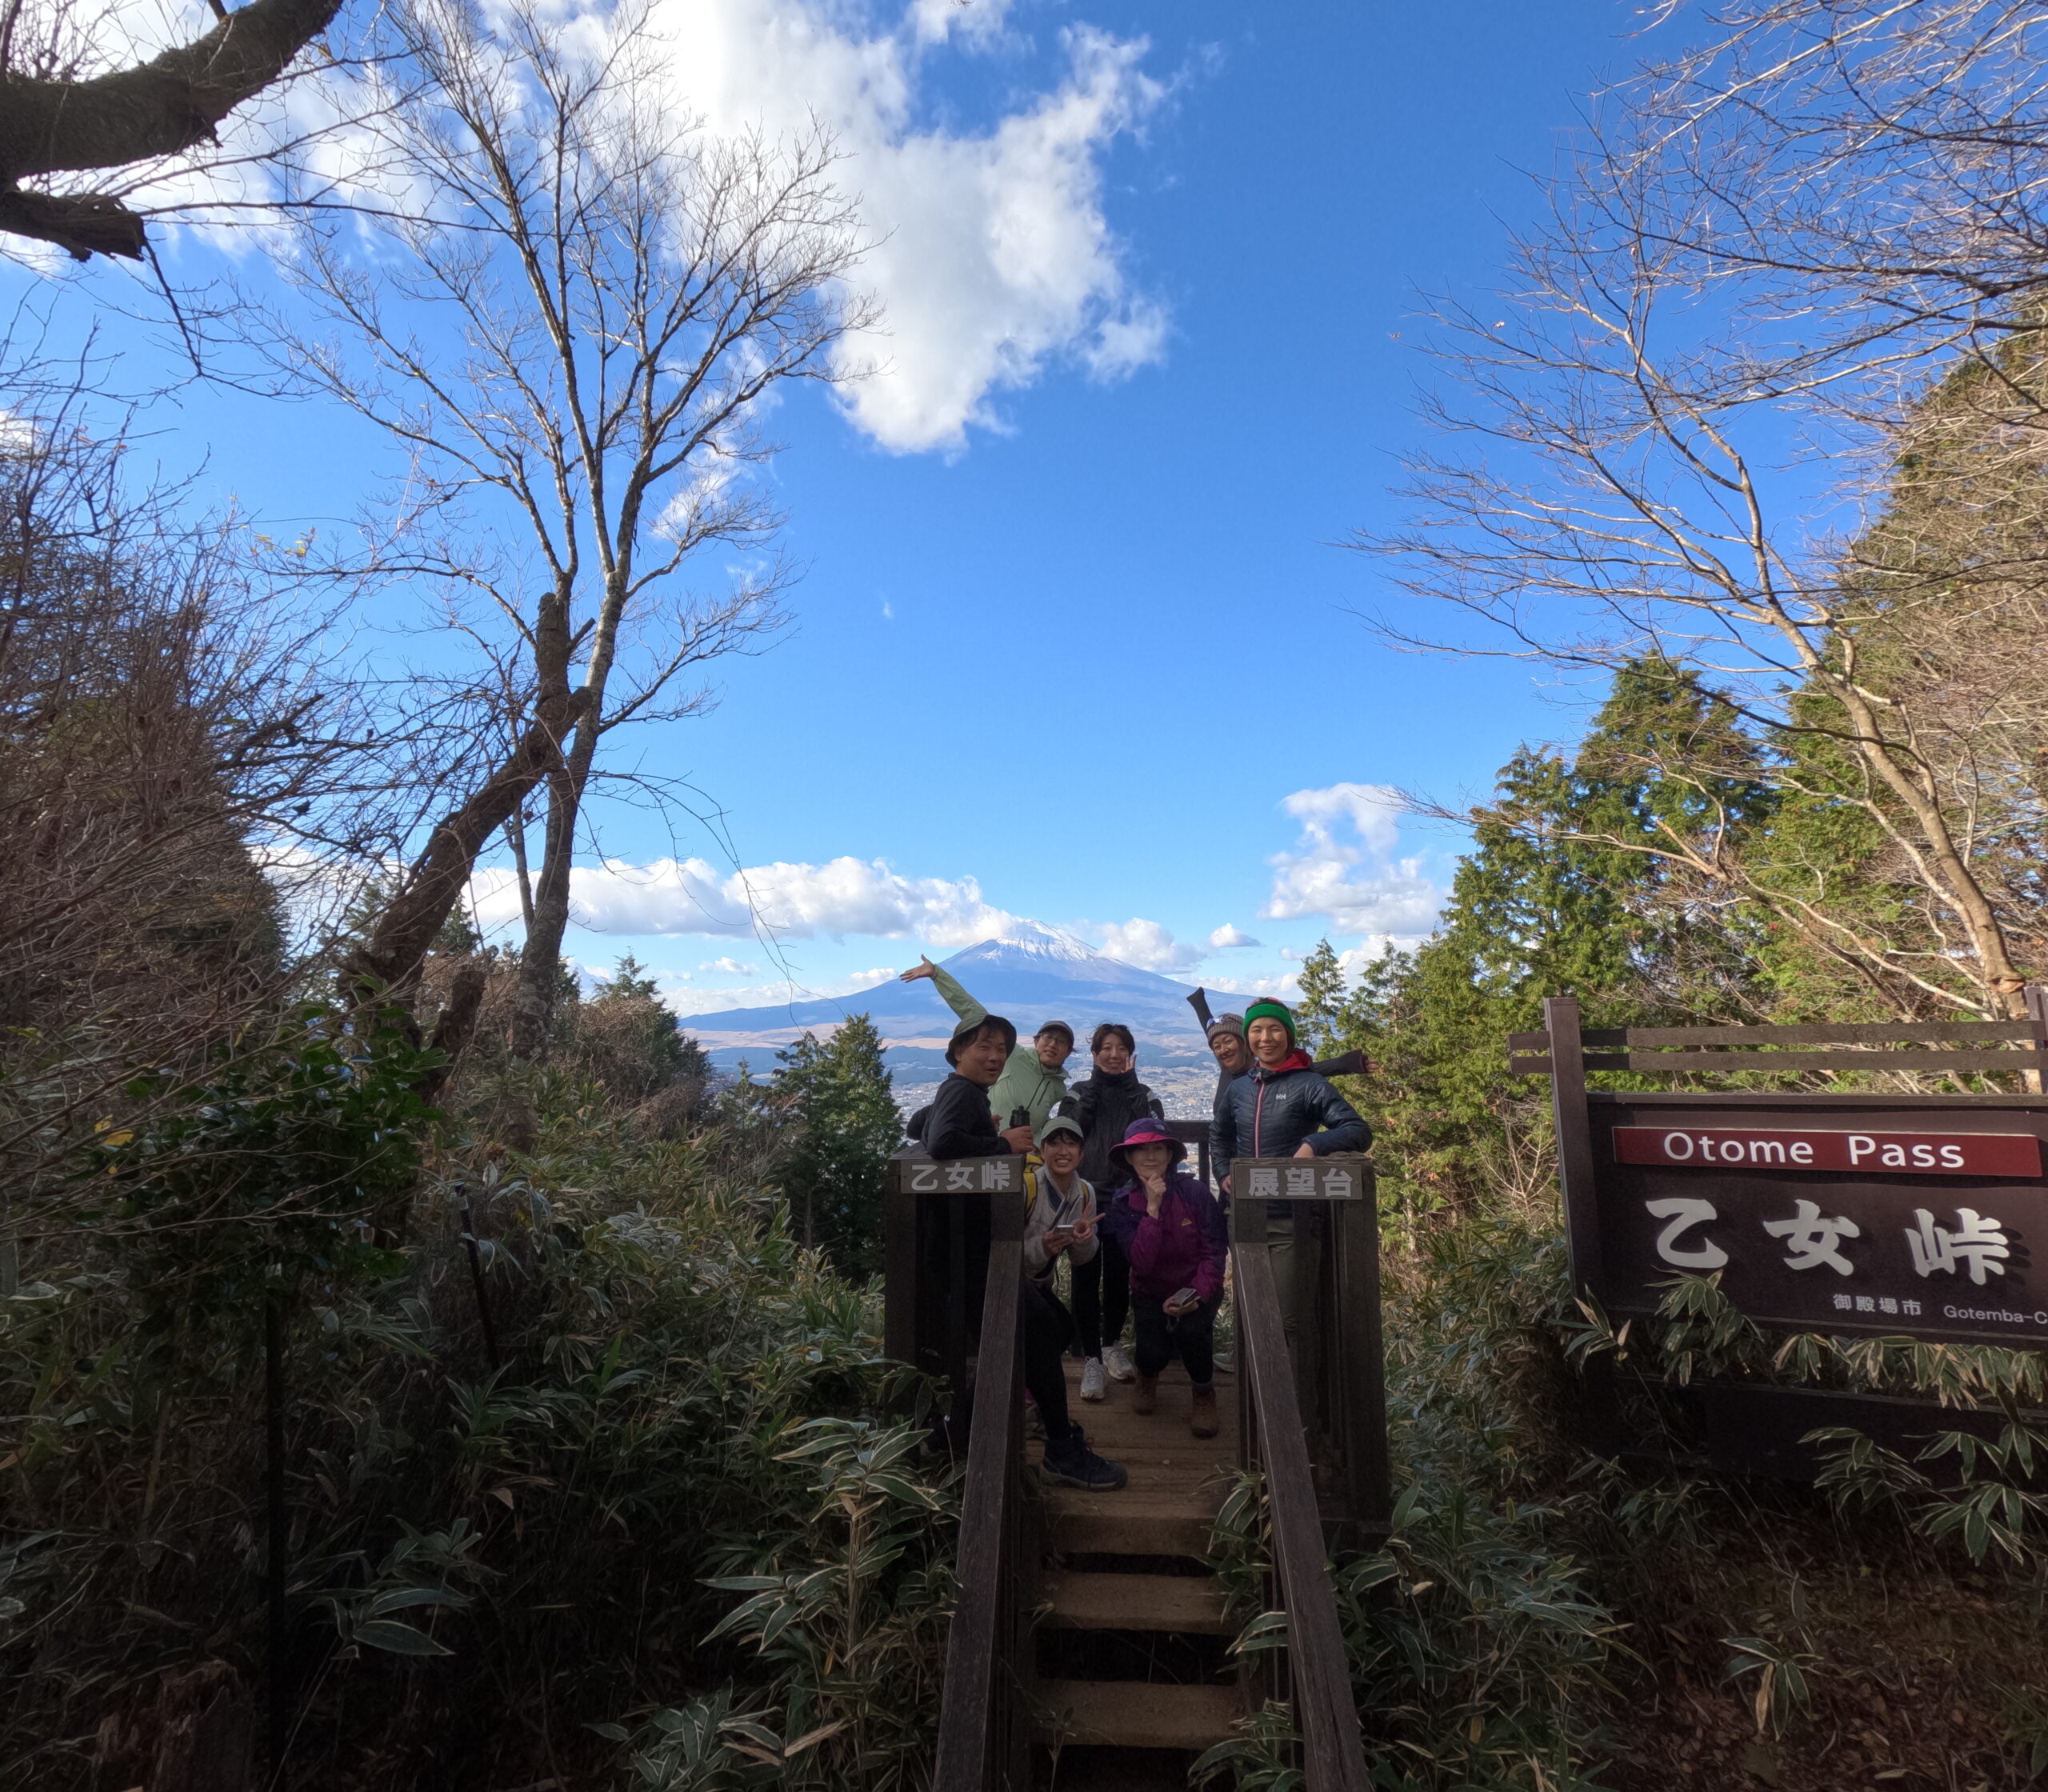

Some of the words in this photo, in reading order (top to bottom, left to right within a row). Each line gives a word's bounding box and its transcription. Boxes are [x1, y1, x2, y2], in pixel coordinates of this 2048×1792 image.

[1664, 1132, 1814, 1164] Otome
[1848, 1135, 1965, 1168] Pass
[910, 1161, 1010, 1191] 乙女峠
[1248, 1167, 1353, 1197] 展望台
[1646, 1198, 2010, 1285] 乙女峠
[1834, 1294, 1922, 1316] 御殿場市
